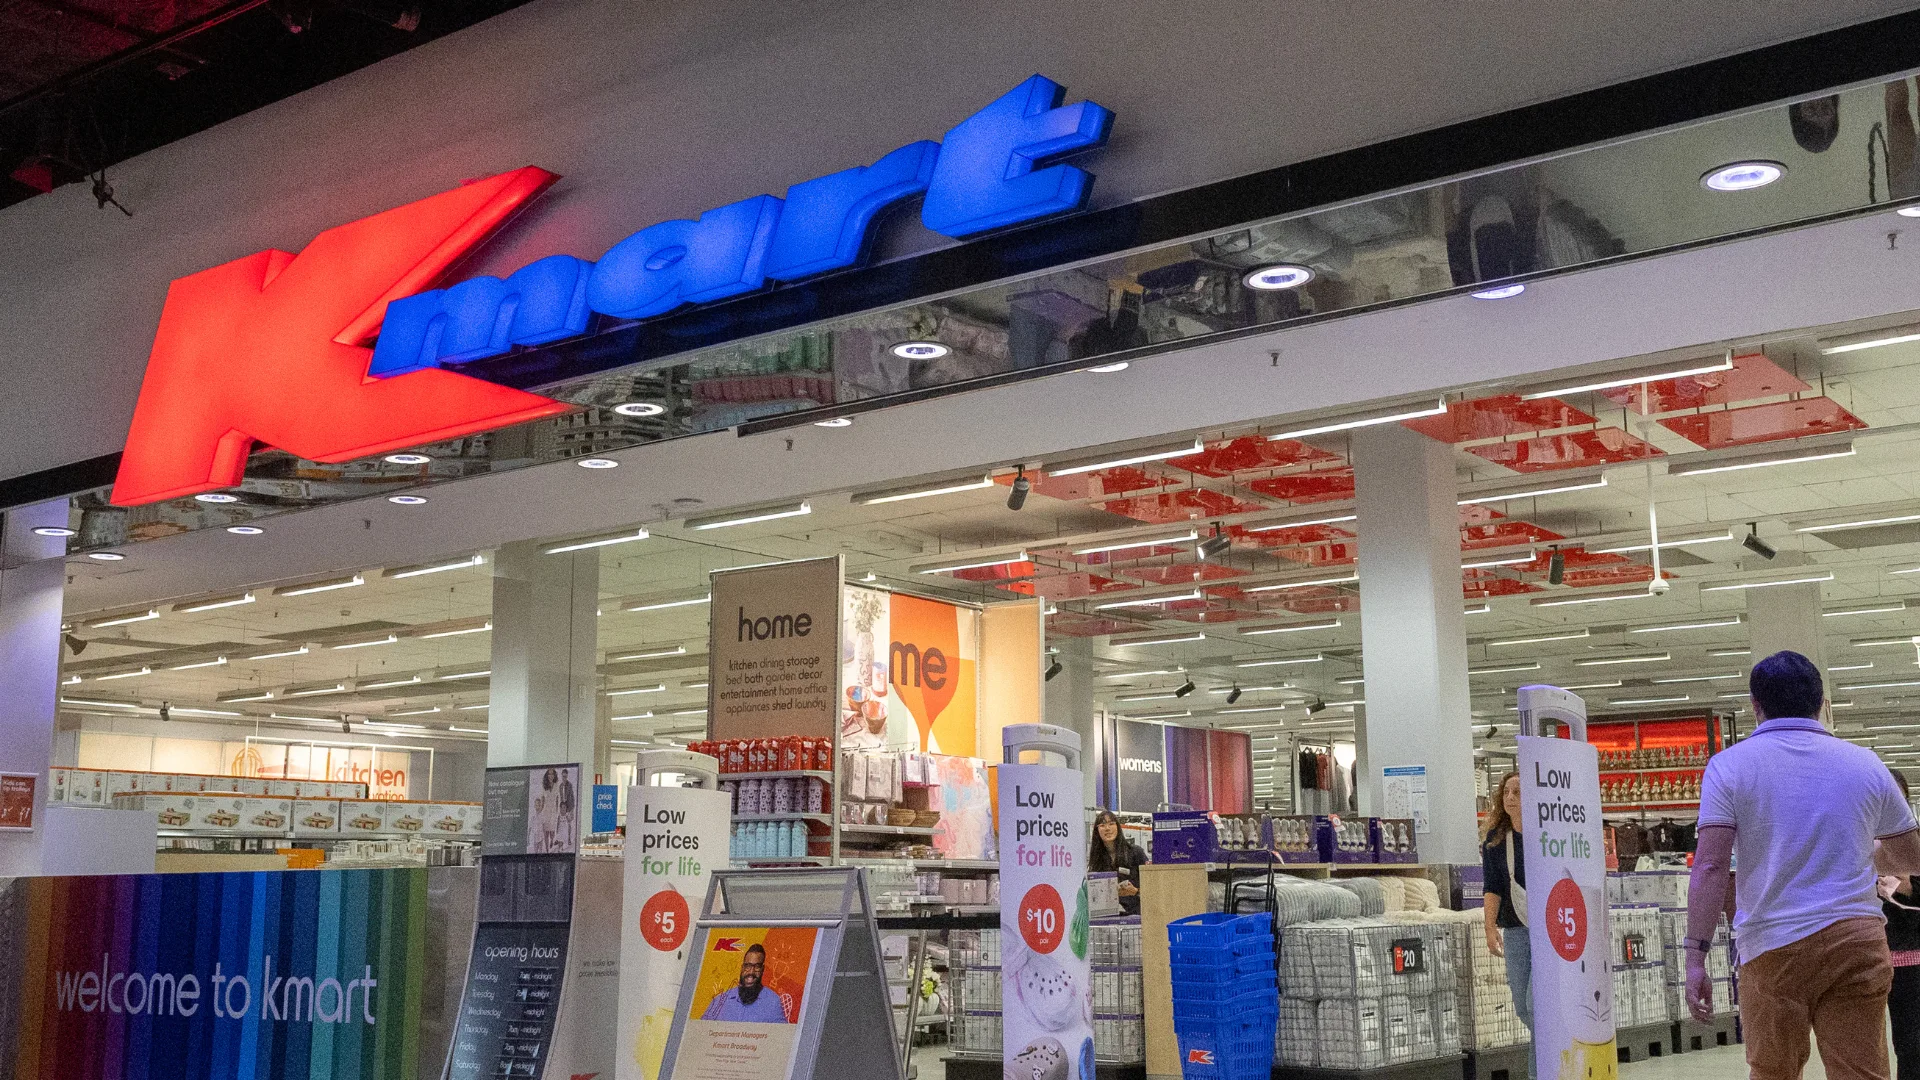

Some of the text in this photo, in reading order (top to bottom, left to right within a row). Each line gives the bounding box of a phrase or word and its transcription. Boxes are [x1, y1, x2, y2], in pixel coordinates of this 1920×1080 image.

[111, 74, 1115, 507] Kmart
[738, 606, 812, 642] home
[729, 655, 820, 671] kitchen dining storage
[726, 670, 823, 686] bed bath garden decor
[720, 684, 828, 700] entertainment home office
[726, 699, 827, 715] appliances shed laundry
[332, 758, 405, 787] kitchen
[1119, 757, 1162, 774] womens
[1535, 761, 1571, 790] Low
[596, 802, 613, 810] check
[597, 793, 613, 802] price
[1016, 785, 1055, 809] Low
[643, 804, 686, 825] Low
[1538, 796, 1586, 828] prices
[1016, 814, 1069, 842] prices
[642, 829, 699, 853] prices
[1539, 831, 1591, 859] for life
[1016, 844, 1073, 868] for life
[641, 855, 701, 876] for life
[654, 911, 675, 934] $5
[1026, 908, 1056, 934] $10
[1558, 907, 1576, 937] $5
[1039, 937, 1049, 945] pair
[1564, 942, 1577, 950] each
[485, 943, 559, 962] opening hours
[474, 971, 499, 983] Monday
[56, 952, 377, 1025] welcome to kmart
[471, 988, 496, 1000] Tuesday
[468, 1006, 502, 1018] Wednesday
[464, 1023, 489, 1035] Thursday
[709, 1030, 768, 1041] Department Managers
[459, 1041, 477, 1053] Friday
[712, 1042, 758, 1052] Kmart Broadway
[455, 1060, 481, 1071] Saturday
